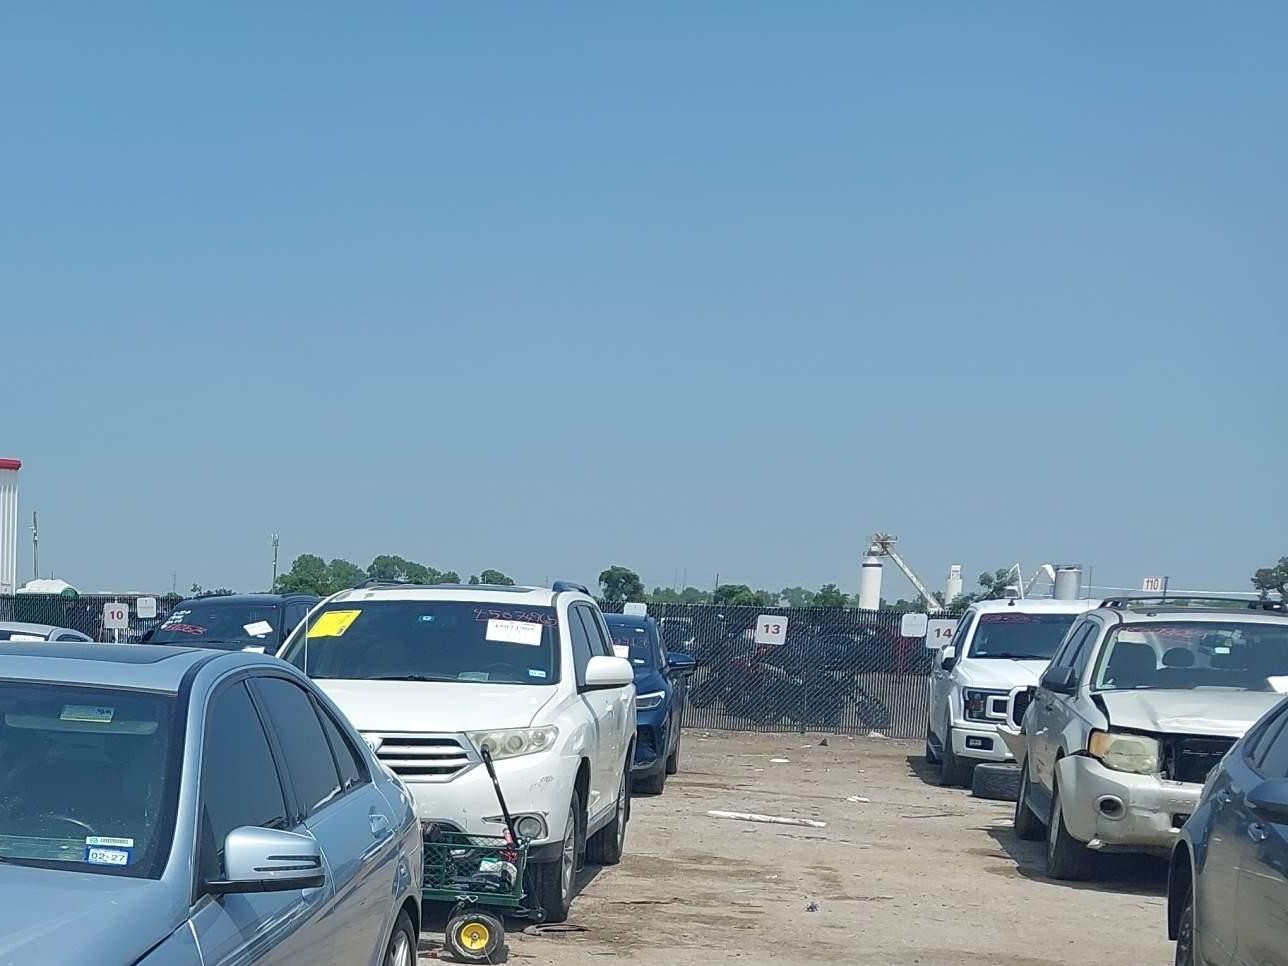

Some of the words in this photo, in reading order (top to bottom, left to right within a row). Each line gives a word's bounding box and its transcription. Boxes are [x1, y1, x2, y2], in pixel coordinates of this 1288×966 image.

[1146, 579, 1158, 590] 110
[110, 610, 123, 620] 10
[764, 624, 780, 635] 13
[934, 628, 952, 639] 14
